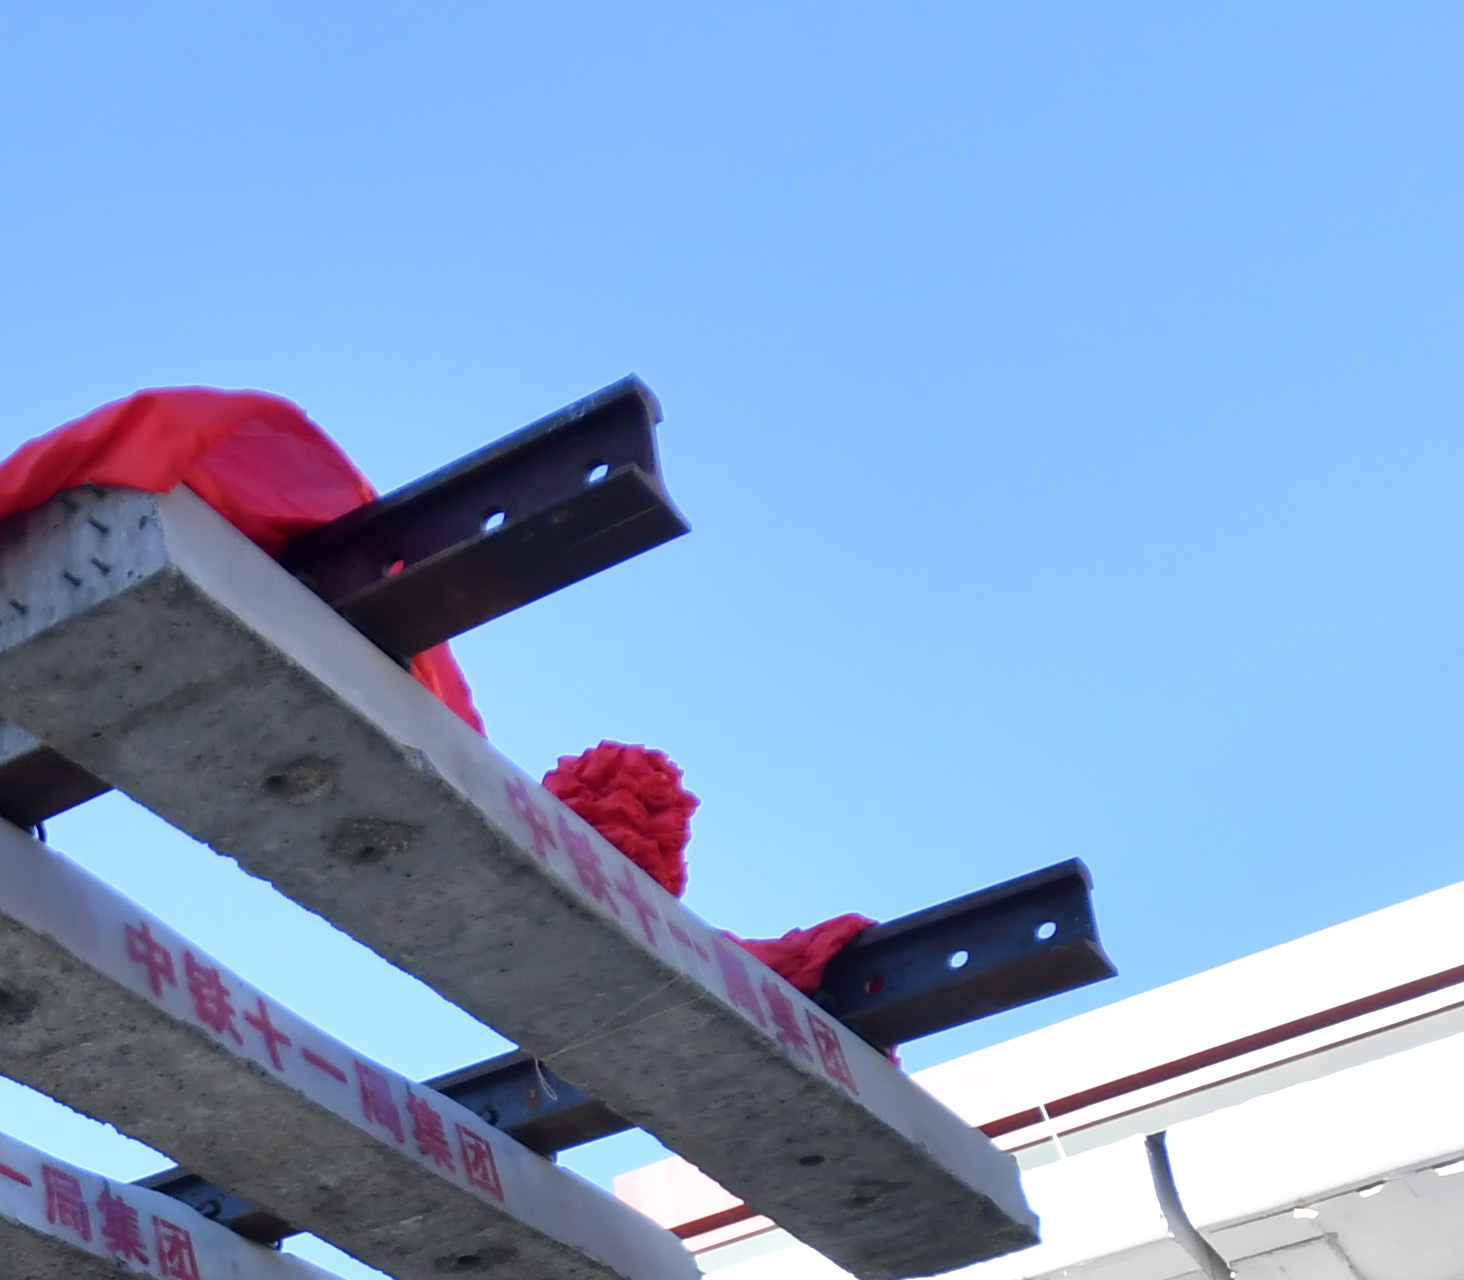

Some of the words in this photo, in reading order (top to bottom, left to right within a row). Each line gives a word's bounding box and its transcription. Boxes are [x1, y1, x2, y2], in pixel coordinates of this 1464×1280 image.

[125, 921, 505, 1203] 中铁十一局集团
[505, 778, 859, 1096] 中铁十一局集团
